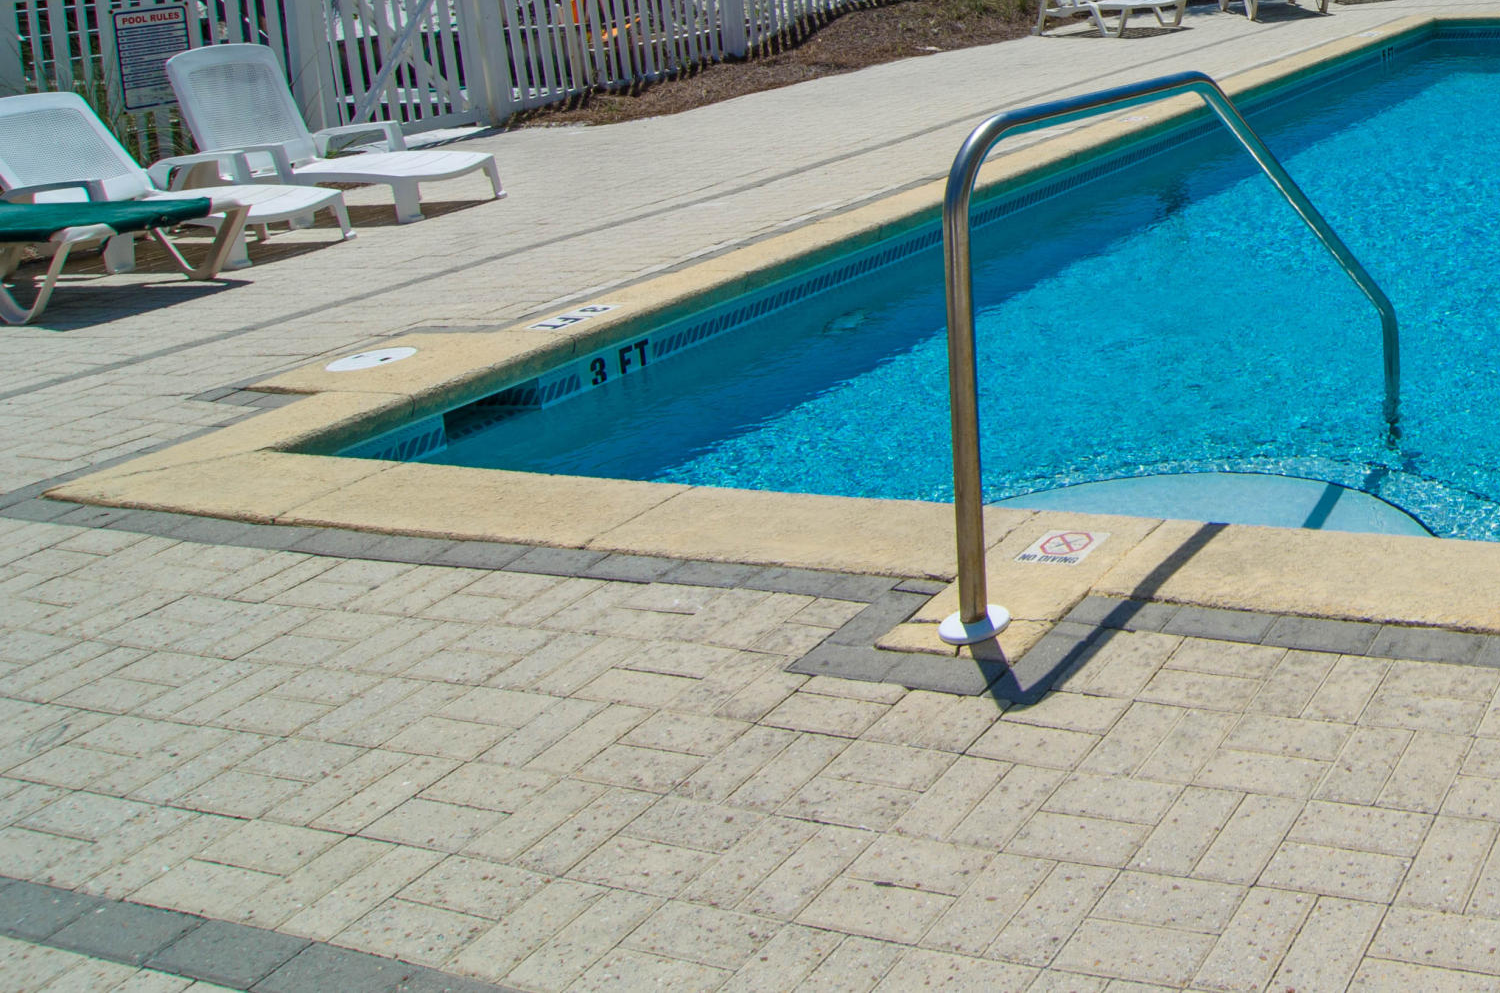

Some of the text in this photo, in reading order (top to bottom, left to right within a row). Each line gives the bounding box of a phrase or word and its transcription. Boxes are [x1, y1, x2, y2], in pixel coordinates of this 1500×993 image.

[122, 12, 180, 25] POOL RULES
[590, 338, 649, 386] 3 FT
[1018, 553, 1079, 564] NO DIVING
